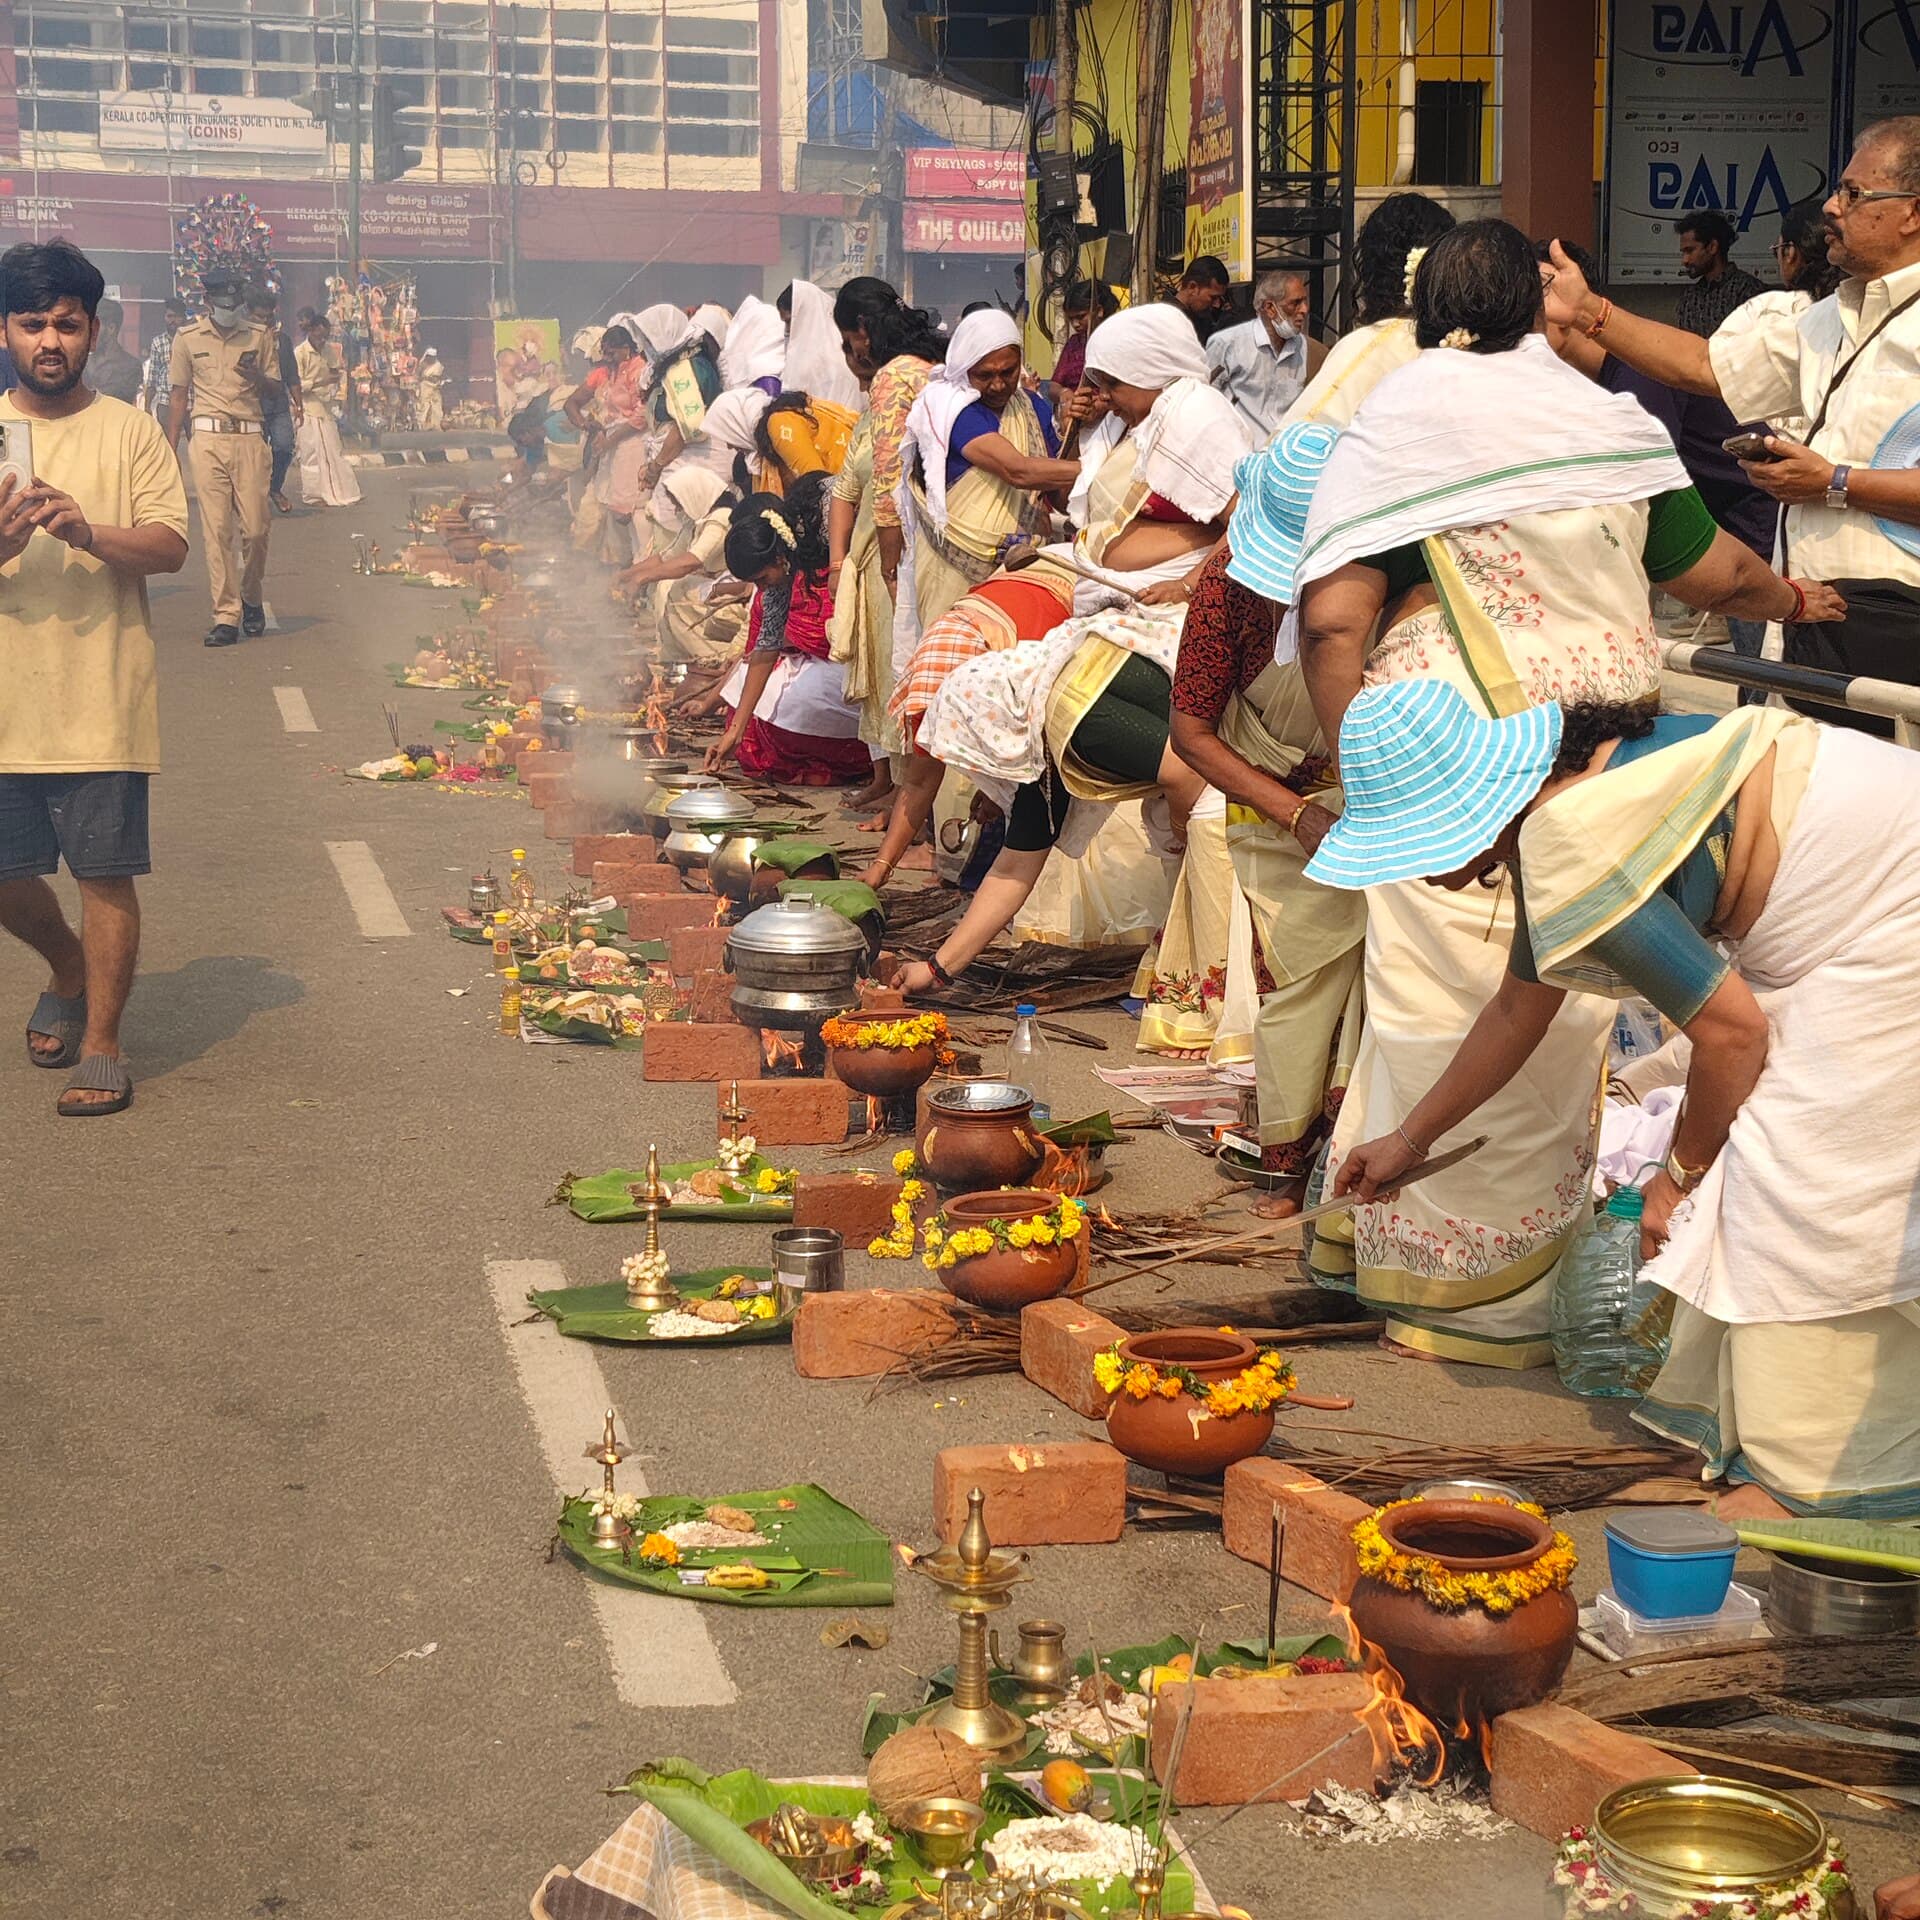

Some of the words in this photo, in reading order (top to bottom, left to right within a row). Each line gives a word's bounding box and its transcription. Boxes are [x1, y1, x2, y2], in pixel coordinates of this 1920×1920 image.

[103, 110, 135, 123] KERALA
[136, 111, 193, 125] CO-OPERATIVE
[195, 113, 238, 126] INSURANCE
[240, 116, 273, 128] SOCIETY
[188, 124, 243, 141] (COINS)
[1647, 141, 1680, 153] ECO
[912, 157, 932, 168] VIP
[934, 157, 986, 170] SKYBAGS
[976, 179, 1006, 191] POPY
[17, 196, 75, 210] KERALA
[17, 208, 59, 221] BANK
[286, 207, 328, 220] KERALA
[362, 209, 438, 224] CO-OPERATIVE
[440, 212, 471, 226] BANK
[917, 219, 954, 241] THE
[958, 220, 1025, 242] QUILON
[1202, 217, 1231, 235] HAMARA
[1202, 231, 1232, 250] CHOICE
